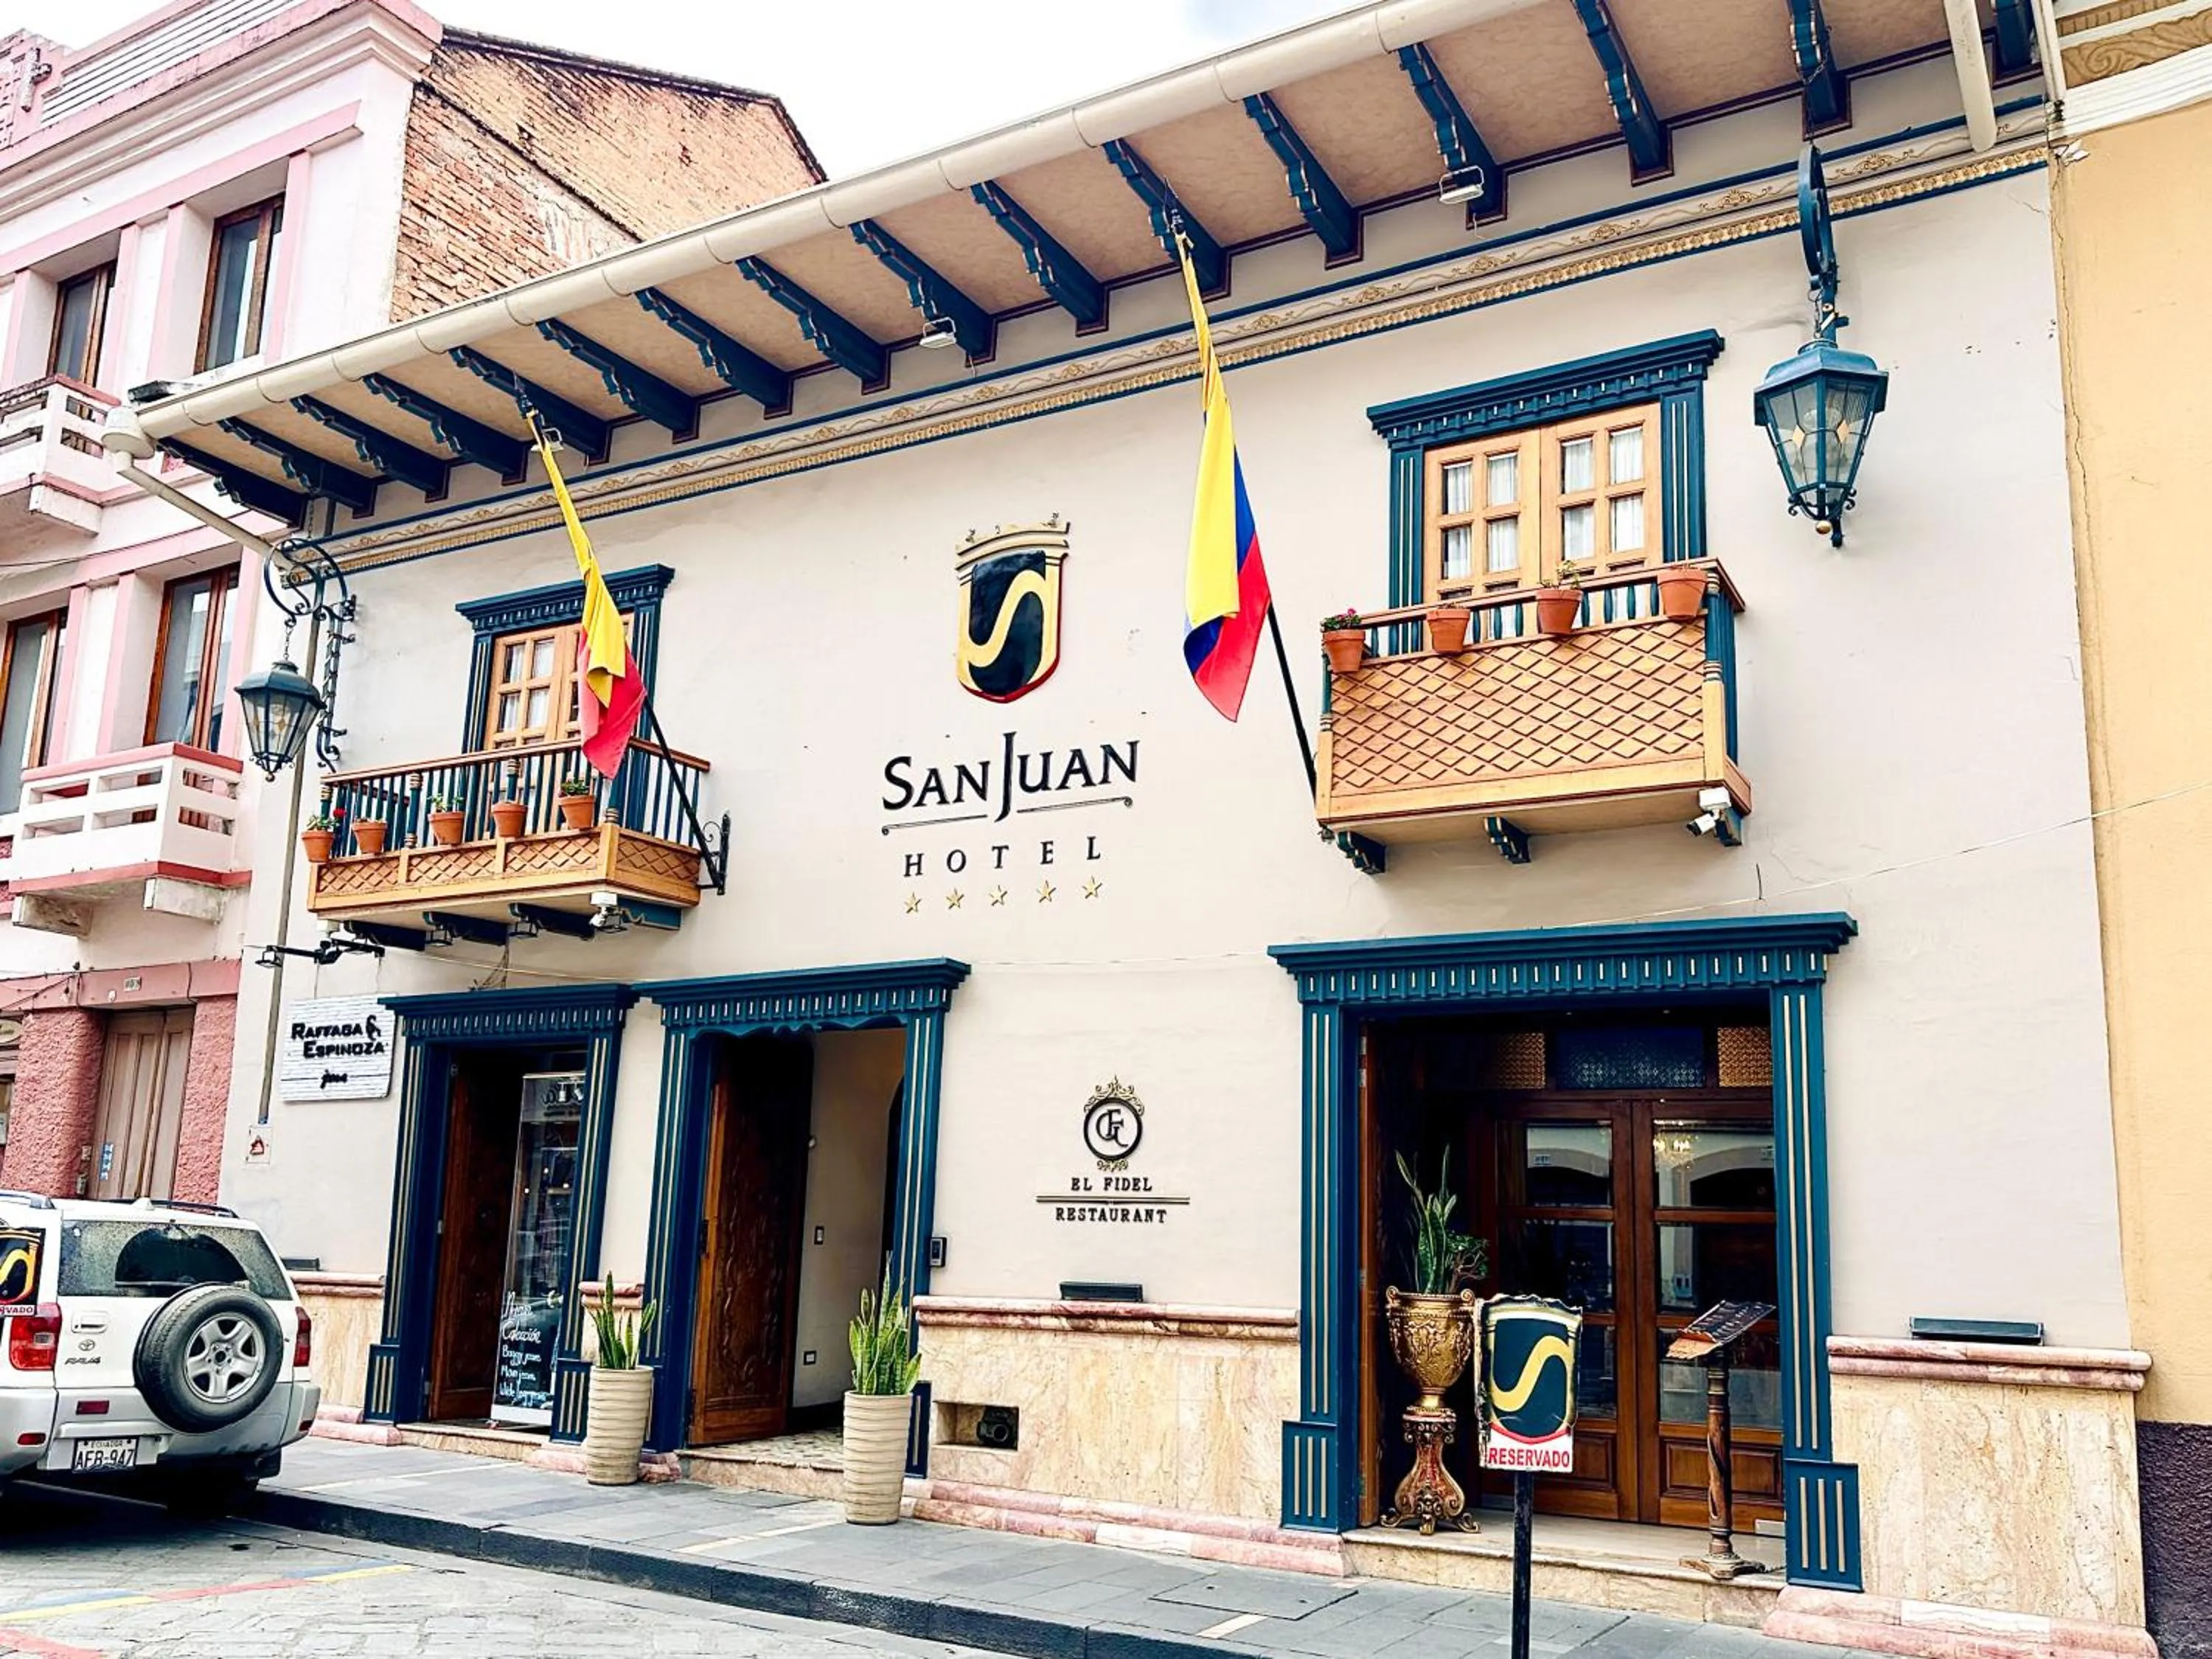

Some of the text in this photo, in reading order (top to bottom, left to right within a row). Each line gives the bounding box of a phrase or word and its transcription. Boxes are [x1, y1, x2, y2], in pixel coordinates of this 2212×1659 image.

[882, 731, 1141, 823] SAN JUAN
[903, 836, 1101, 877] HOTEL
[304, 1040, 384, 1059] ESPINOZA
[1071, 1177, 1152, 1192] EL FIDEL
[1055, 1207, 1167, 1223] RESTAURANT
[1488, 1447, 1571, 1467] RESERVADO
